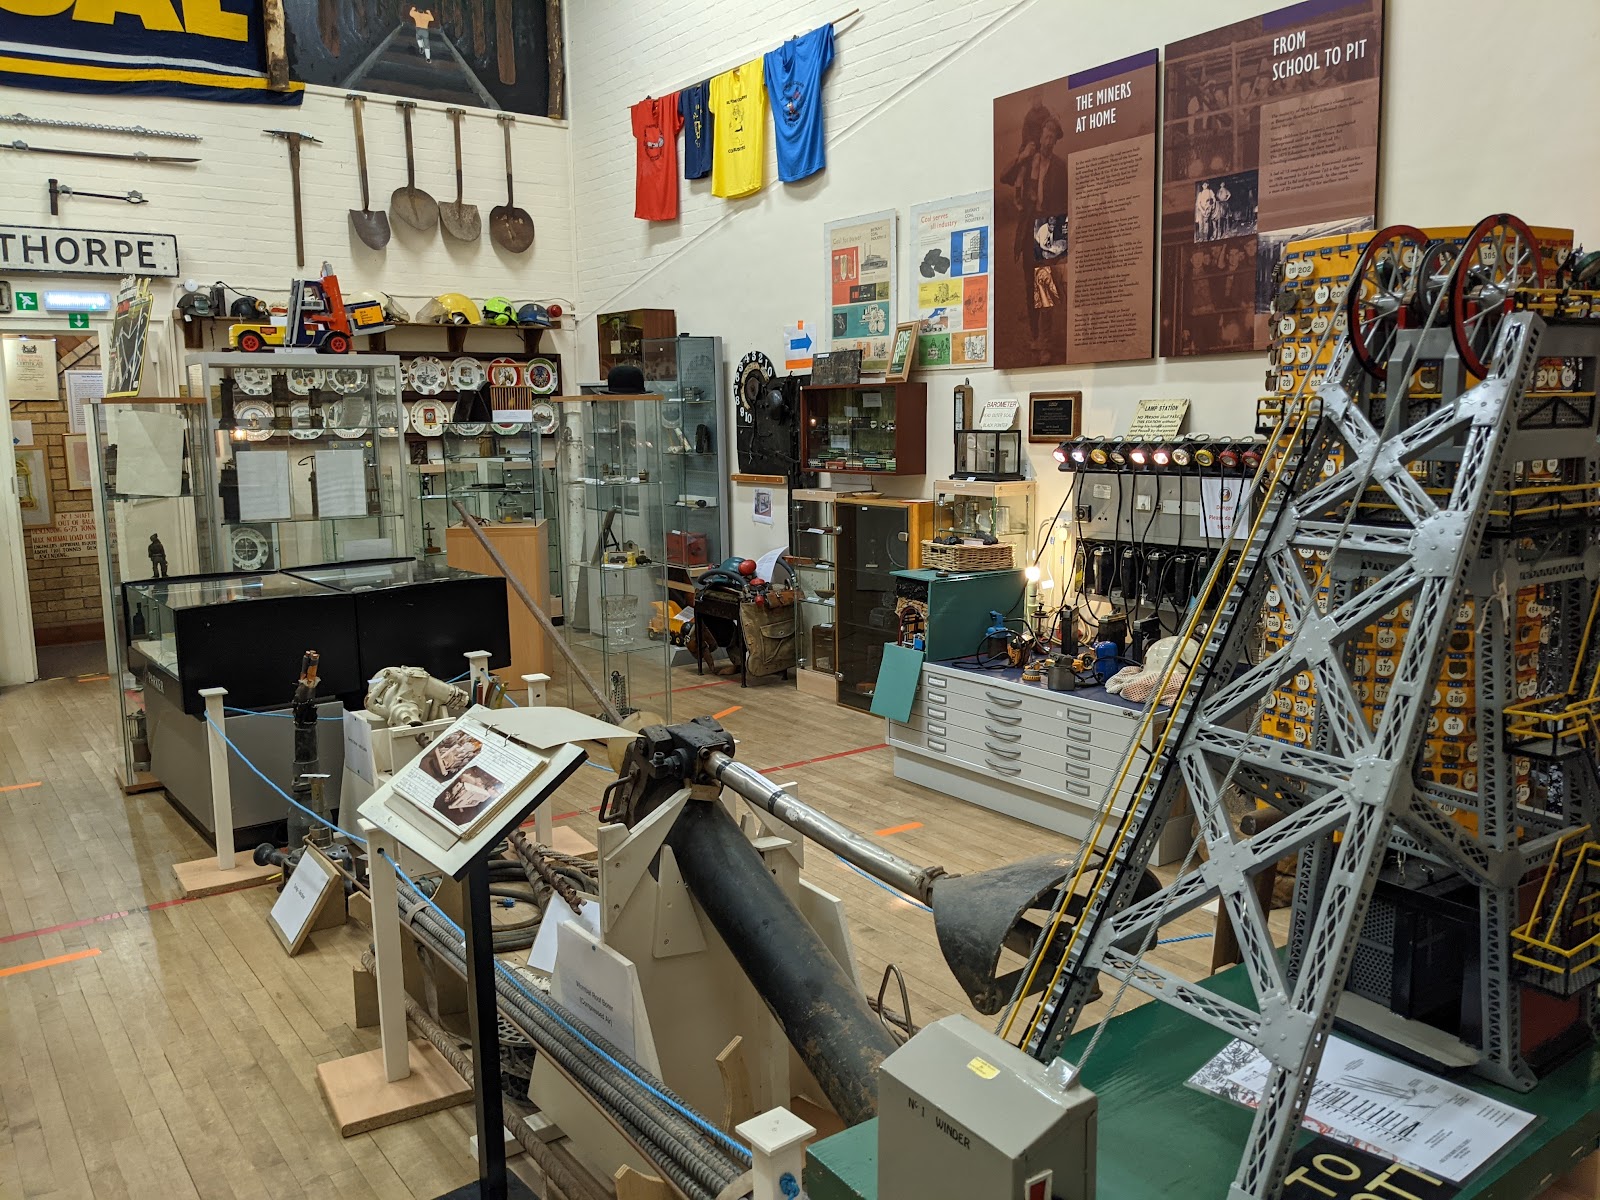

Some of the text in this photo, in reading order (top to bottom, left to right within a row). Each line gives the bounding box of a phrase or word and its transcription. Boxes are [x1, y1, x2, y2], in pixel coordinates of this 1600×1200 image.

[1273, 30, 1306, 56] FROM
[1272, 38, 1367, 81] SCHOOL TO PIT
[1076, 81, 1132, 112] THE MINERS
[1075, 108, 1116, 133] AT HOME
[0, 233, 156, 268] THORPE
[752, 351, 756, 360] 3
[758, 353, 763, 363] 2
[765, 359, 768, 369] 1
[768, 367, 772, 377] 0
[734, 385, 738, 394] 7
[736, 396, 740, 405] 8
[745, 412, 752, 423] 10
[921, 1107, 925, 1118] 1
[936, 1116, 970, 1150] WINDER
[1284, 1153, 1362, 1198] TO
